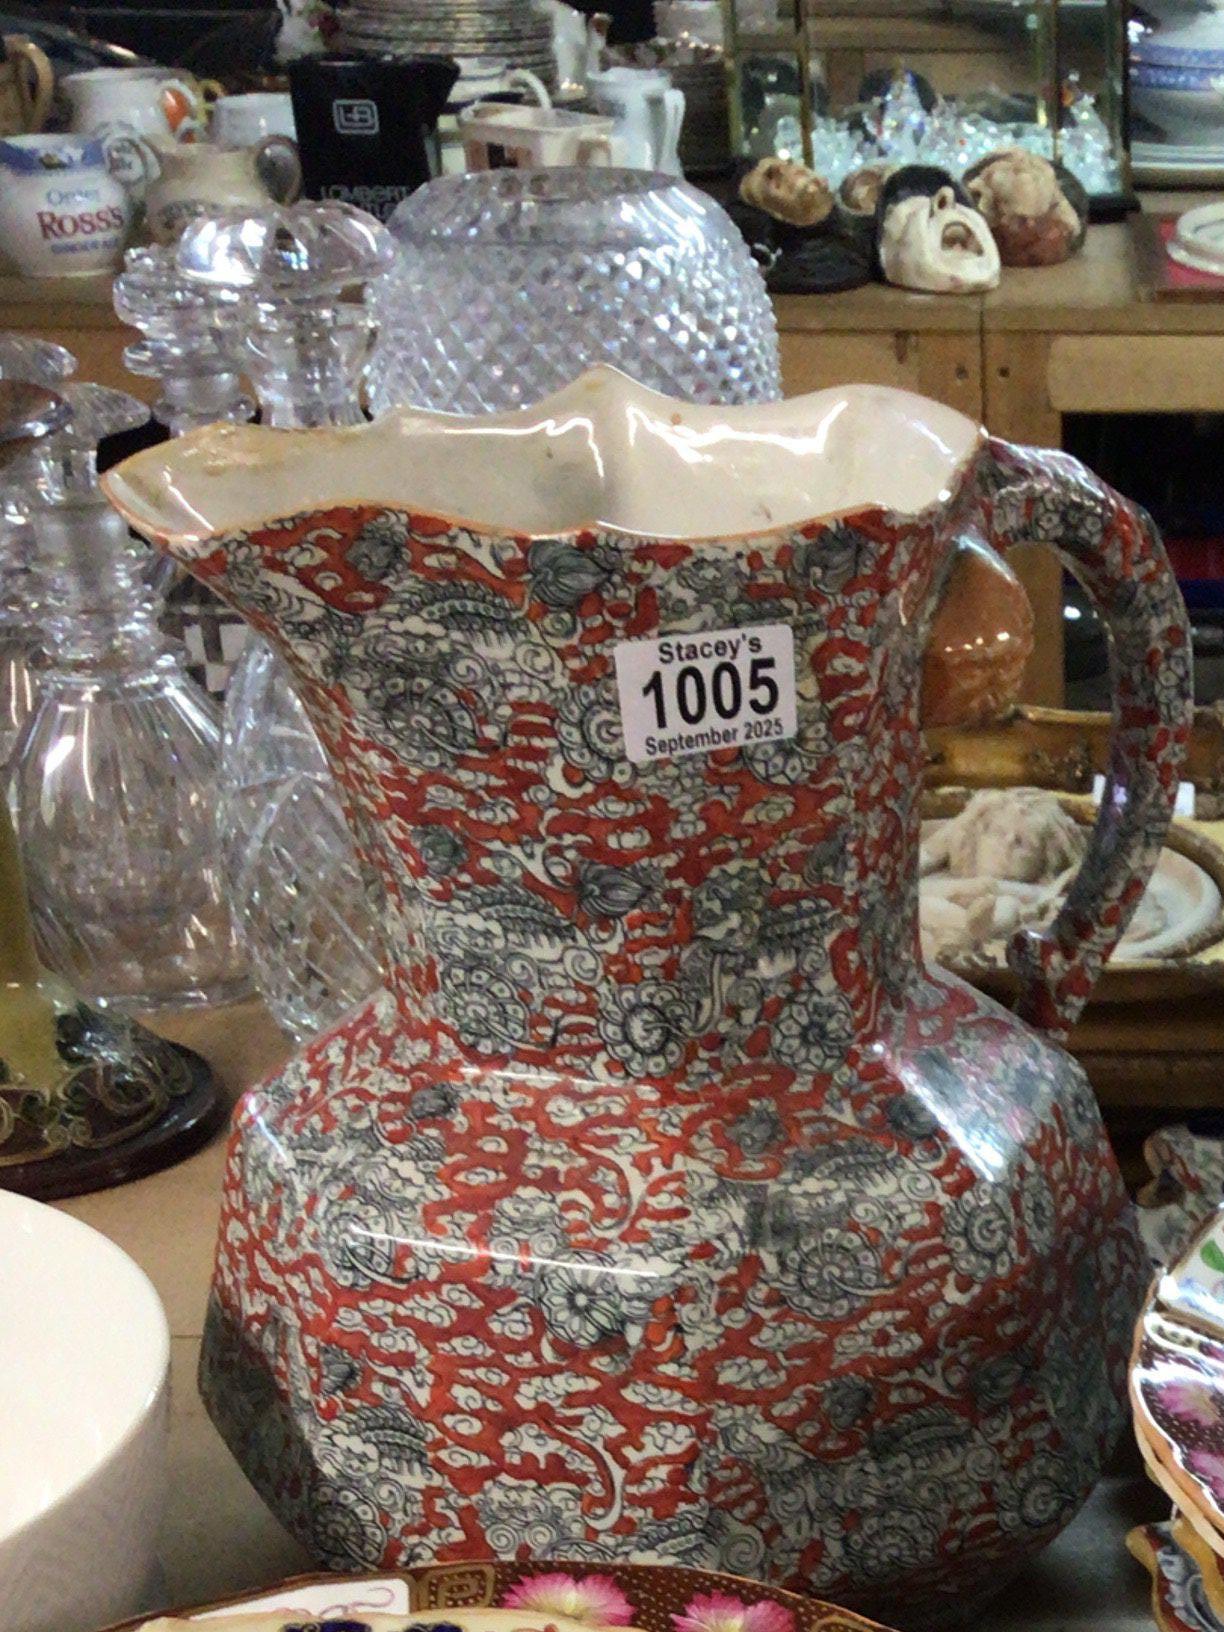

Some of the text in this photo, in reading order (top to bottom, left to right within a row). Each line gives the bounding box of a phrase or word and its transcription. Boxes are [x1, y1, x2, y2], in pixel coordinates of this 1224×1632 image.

[659, 633, 763, 664] Stacey's
[642, 657, 779, 729] 1005
[645, 718, 784, 756] September 2025
